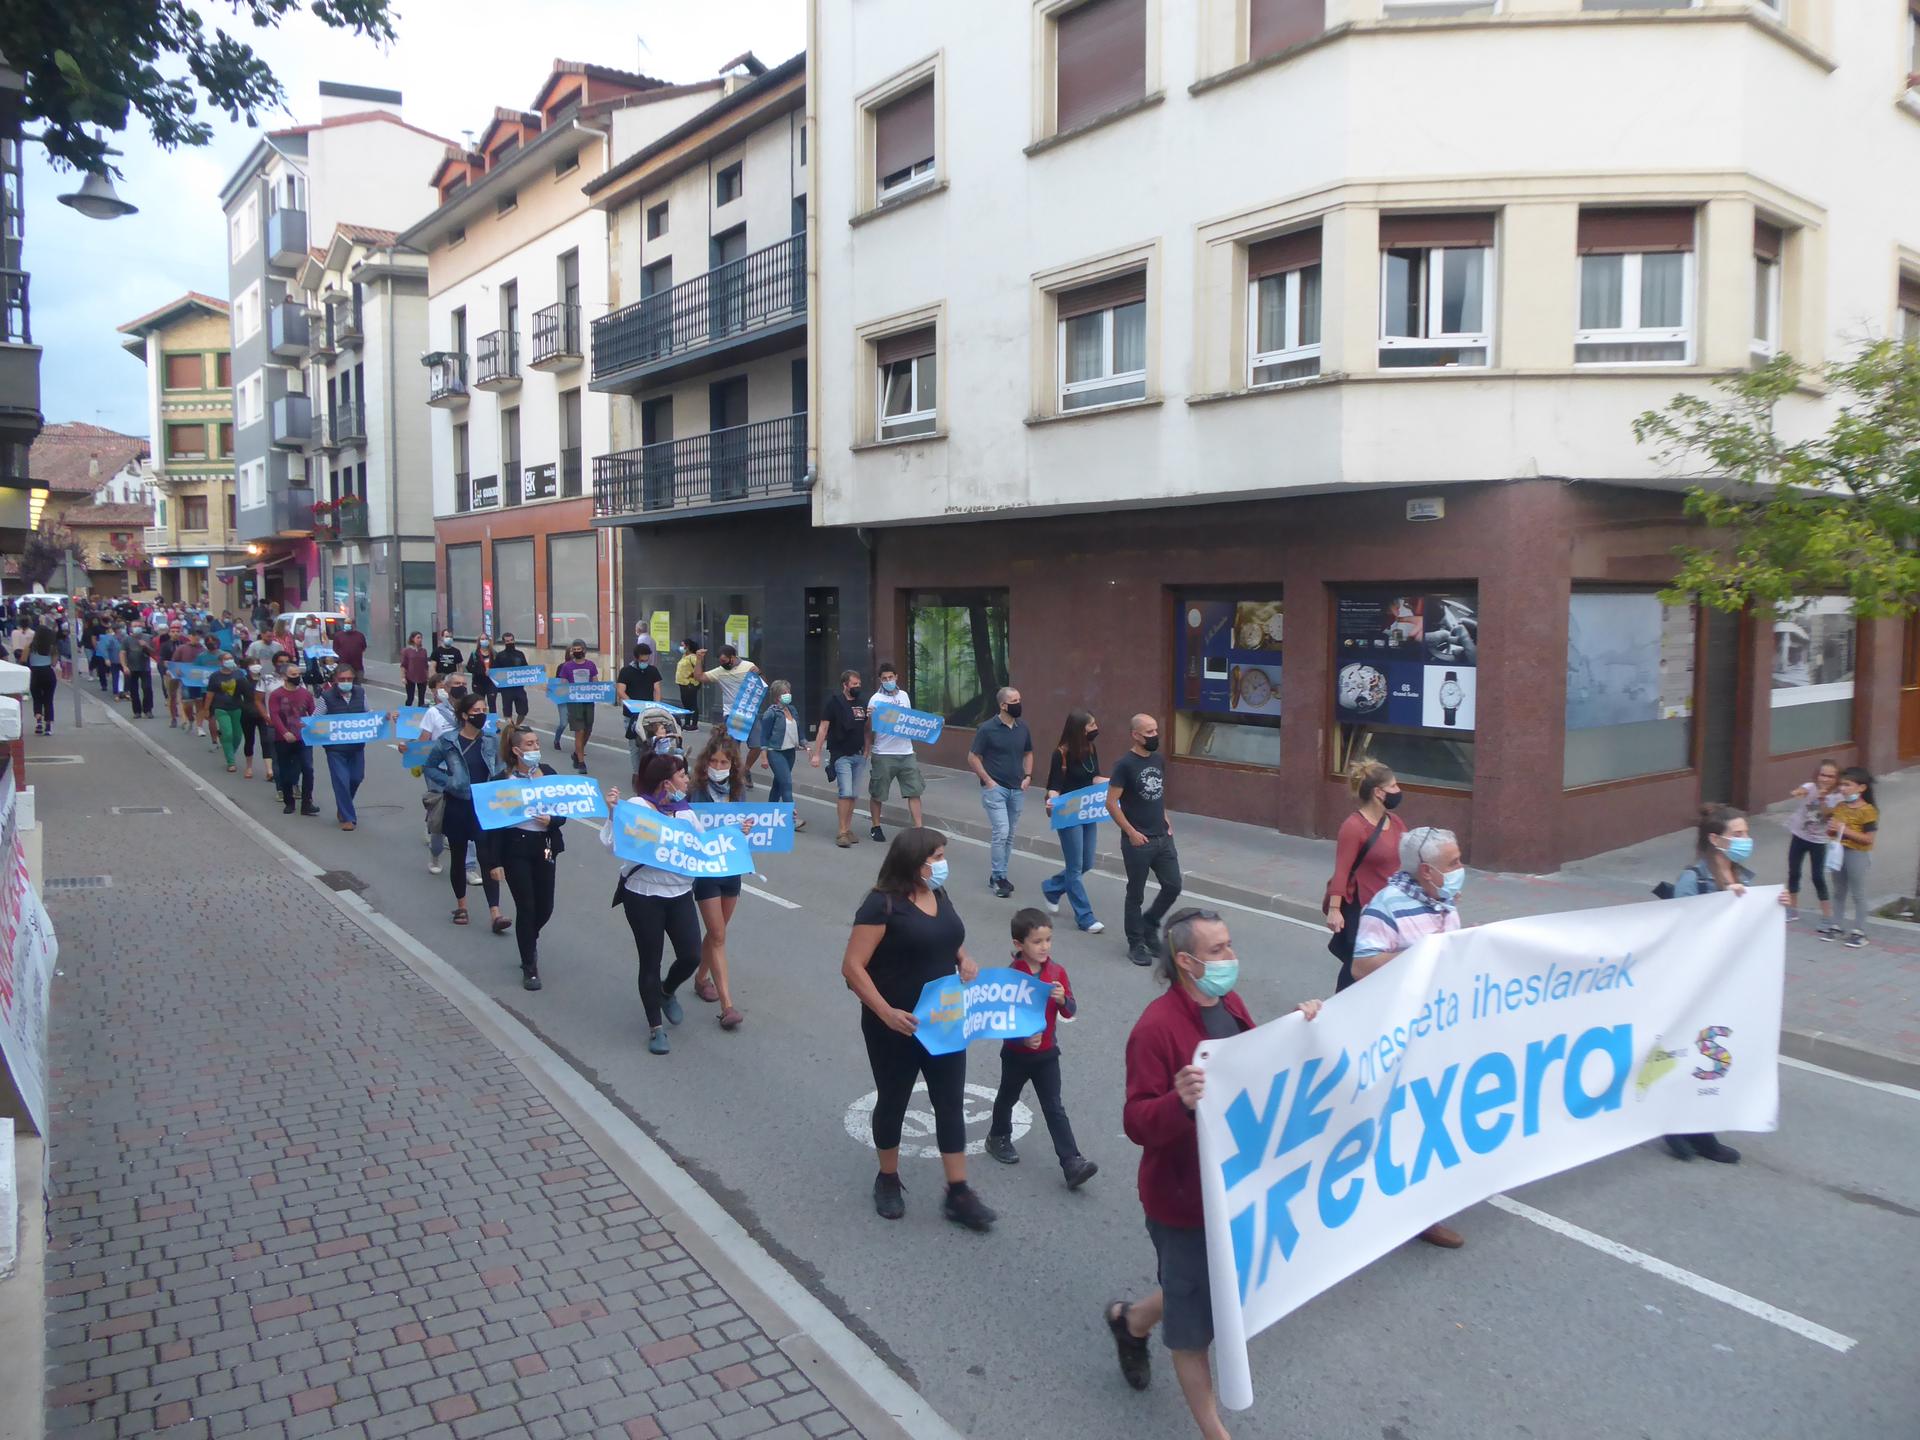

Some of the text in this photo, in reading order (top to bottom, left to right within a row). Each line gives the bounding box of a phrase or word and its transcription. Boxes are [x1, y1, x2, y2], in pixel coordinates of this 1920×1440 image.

[507, 667, 541, 678] presoak
[507, 675, 538, 685] etxera!
[569, 684, 610, 693] presoak
[569, 691, 605, 700] etxera!
[736, 676, 758, 716] presoak
[329, 714, 383, 731] presoak
[896, 712, 939, 730] presoak
[329, 727, 378, 741] etxera!
[893, 723, 929, 738] etxera!
[521, 781, 598, 805] presoak
[523, 797, 595, 817] etxera!
[656, 846, 728, 873] etxera!
[963, 979, 1036, 1017] presoak
[1416, 989, 1459, 1037] eta
[1473, 952, 1636, 1020] iheslariak
[1317, 1023, 1632, 1229] etxera
